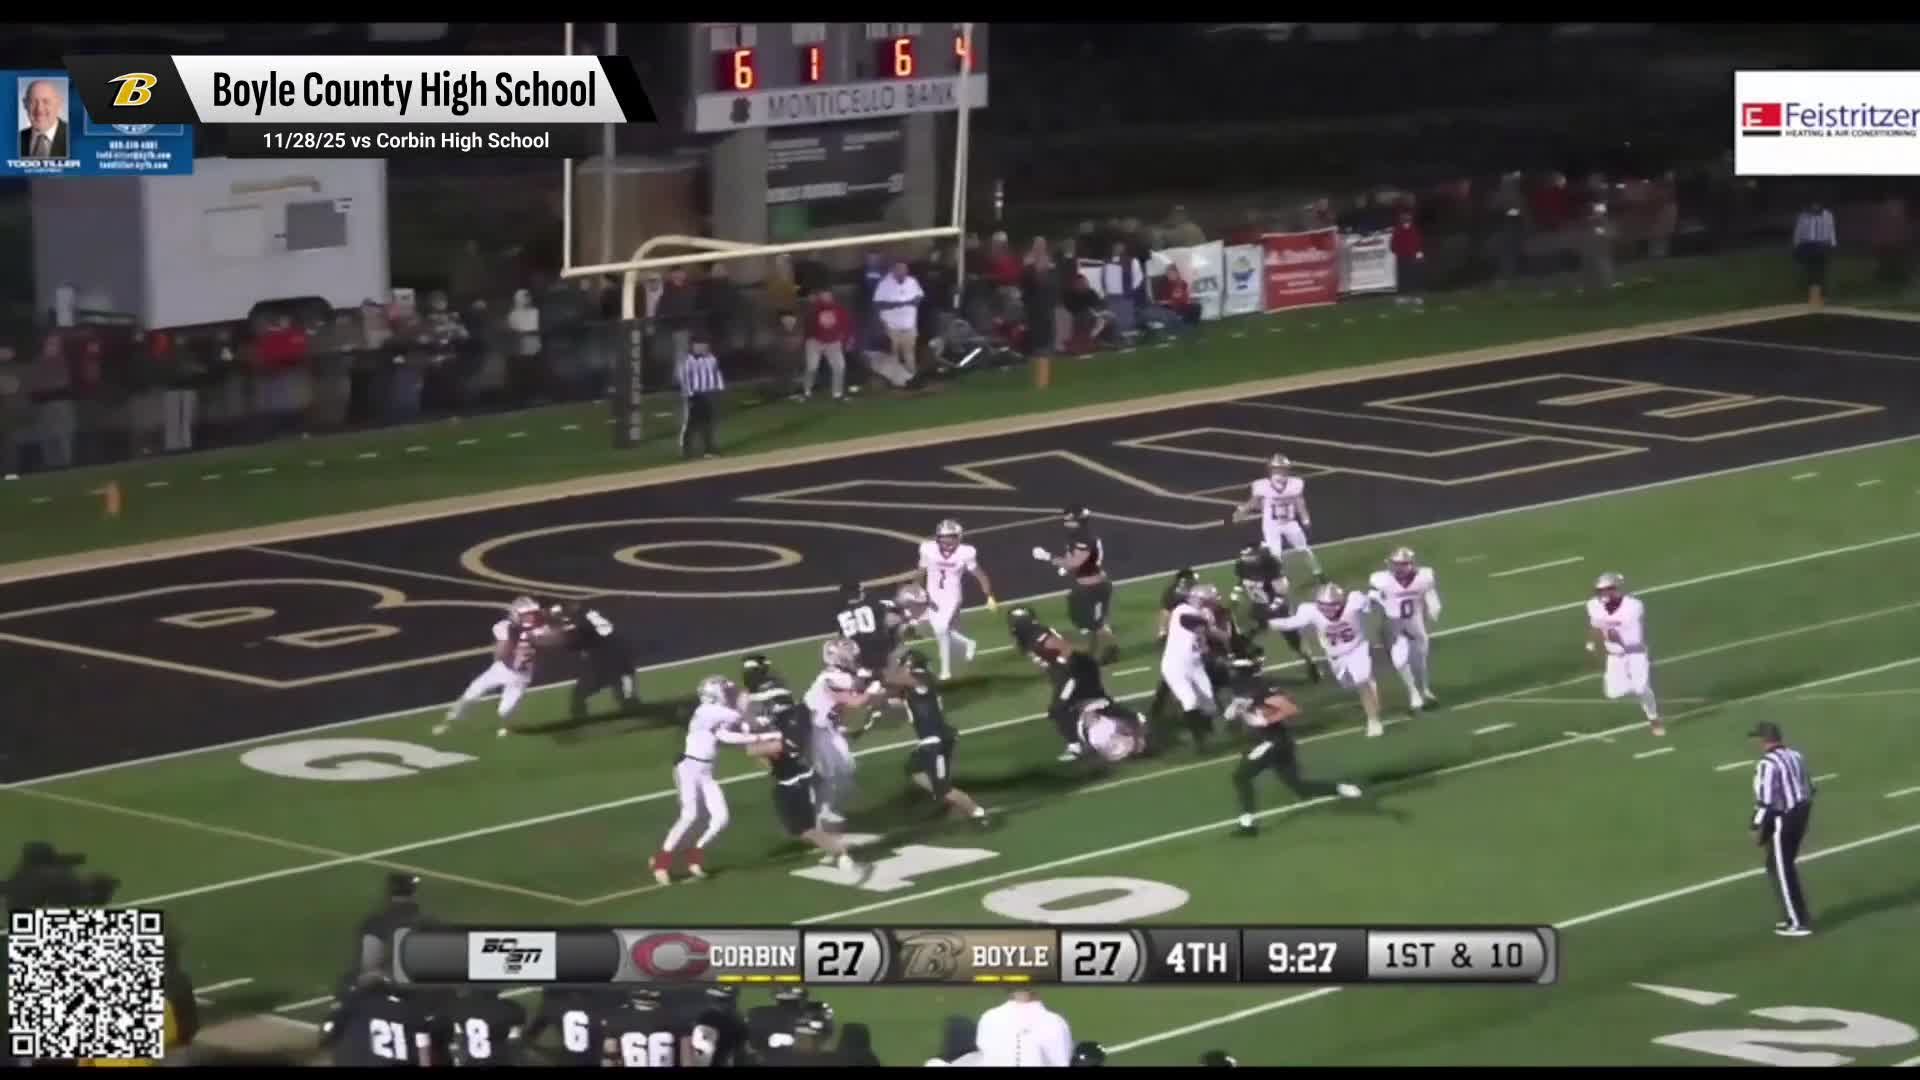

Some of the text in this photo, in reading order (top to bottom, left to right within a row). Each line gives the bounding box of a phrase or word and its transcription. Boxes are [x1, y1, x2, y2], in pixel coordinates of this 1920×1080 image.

[734, 50, 752, 89] 6
[810, 47, 818, 81] 1
[895, 38, 912, 77] 6
[768, 81, 957, 119] MONTICELLO BANK
[240, 737, 480, 780] G
[369, 1018, 408, 1061] 21
[465, 1018, 492, 1060] 8
[561, 1010, 590, 1053] 6
[620, 1031, 676, 1067] 66
[1650, 1005, 1920, 1067] 2
